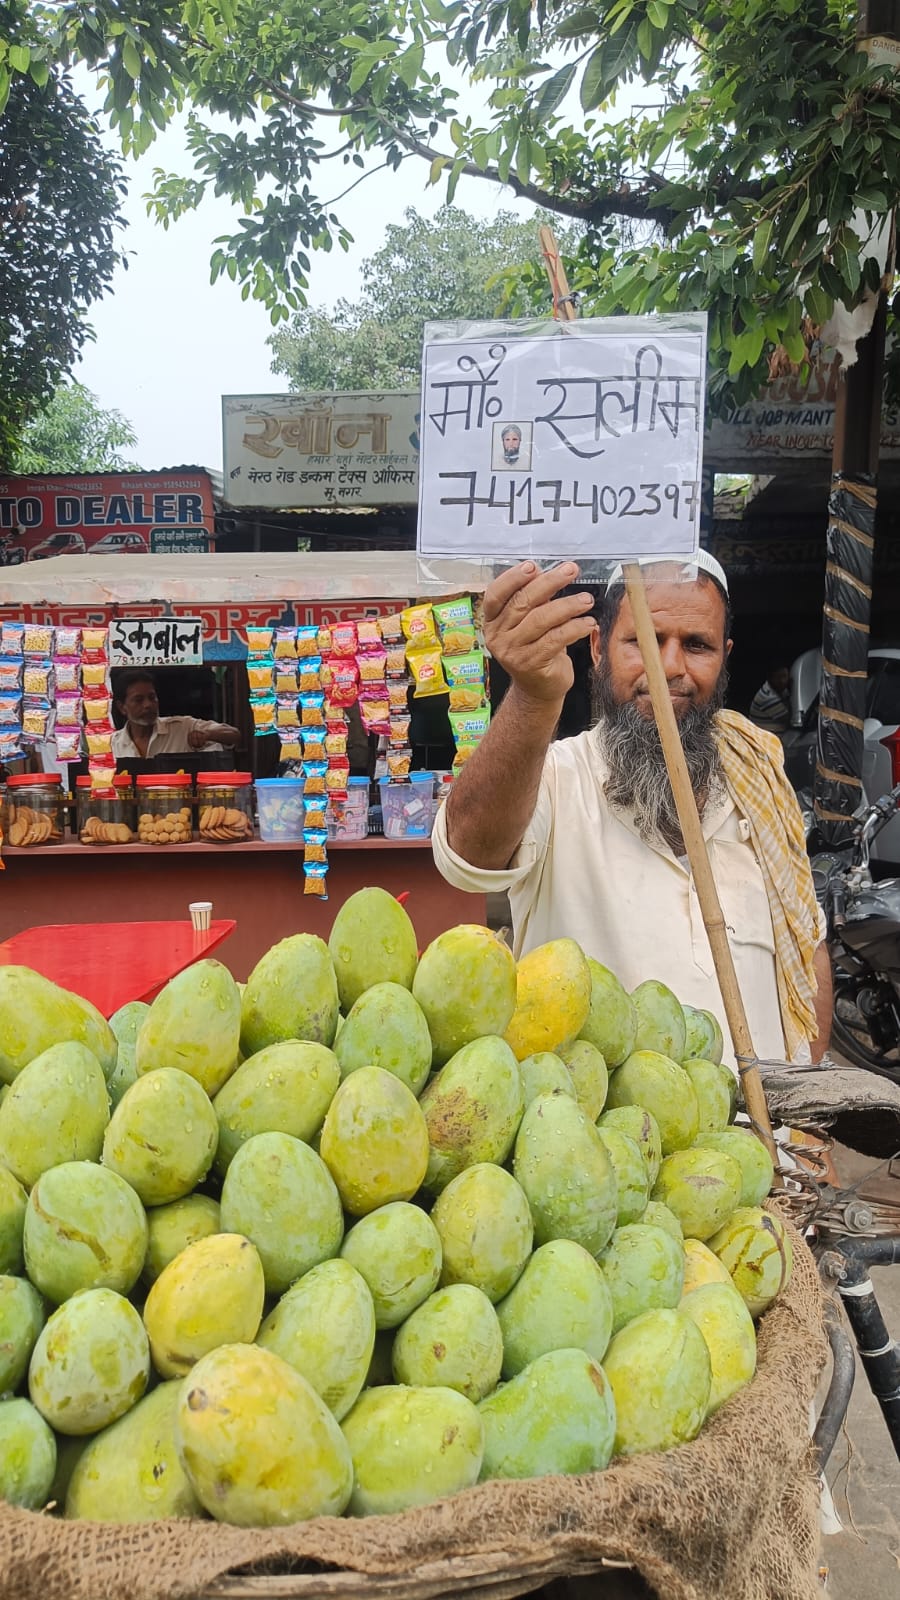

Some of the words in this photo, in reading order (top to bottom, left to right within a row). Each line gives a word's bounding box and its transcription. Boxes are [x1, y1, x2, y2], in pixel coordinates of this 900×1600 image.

[535, 344, 702, 459] सलीम
[276, 467, 297, 484] रोड
[55, 492, 205, 528] DEALER
[438, 471, 700, 526] 7417402397
[112, 618, 202, 658] इकबाल
